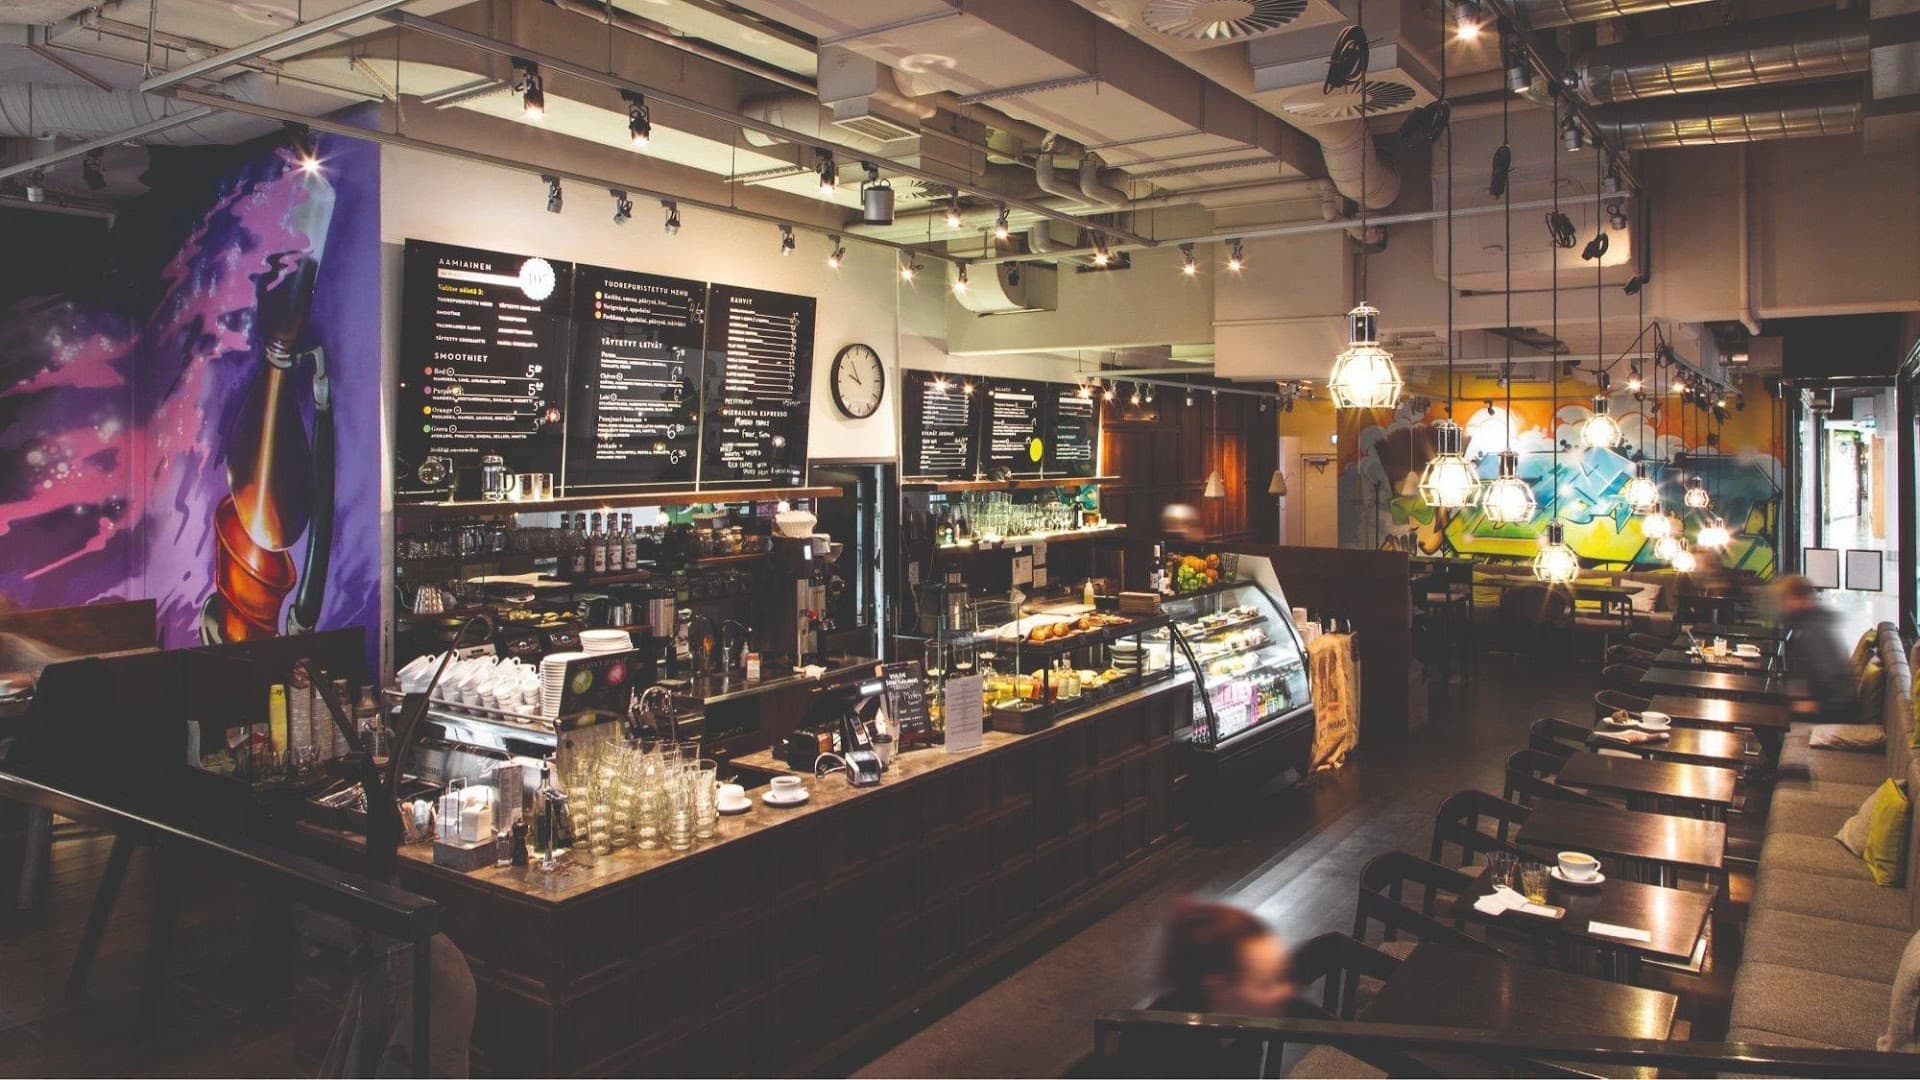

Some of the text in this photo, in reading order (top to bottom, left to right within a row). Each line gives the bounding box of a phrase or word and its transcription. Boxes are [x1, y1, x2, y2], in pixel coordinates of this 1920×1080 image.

[438, 258, 492, 271] AAMIAINEN
[604, 280, 668, 294] TUOREPURISTETTU
[730, 296, 752, 304] KAHVIT
[601, 337, 663, 349] TÄYTETYT LEIVÄT
[434, 352, 488, 363] SMOOTHIET
[723, 409, 758, 417] IERAILEVA
